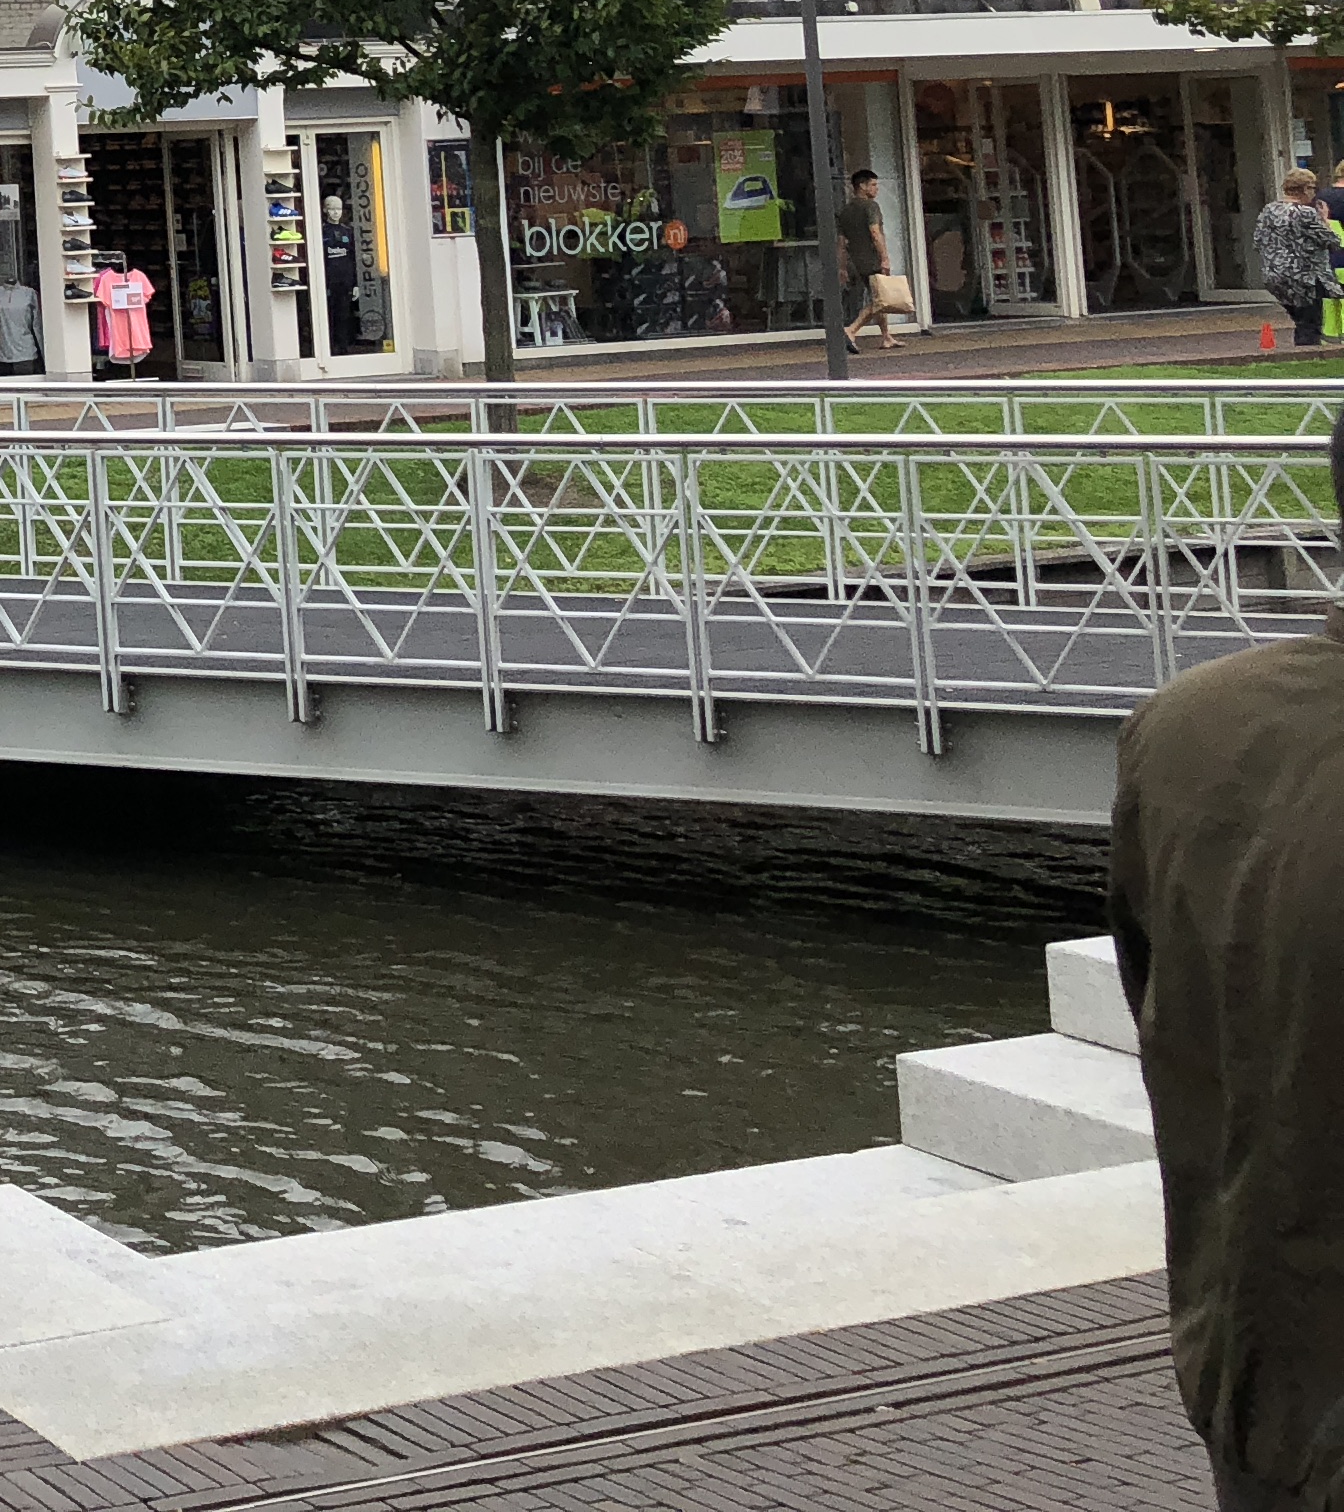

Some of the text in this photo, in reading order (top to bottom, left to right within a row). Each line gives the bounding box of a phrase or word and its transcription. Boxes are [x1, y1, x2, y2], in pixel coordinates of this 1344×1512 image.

[517, 151, 544, 181] bij
[520, 178, 622, 205] nieuwste
[521, 215, 663, 257] blokker
